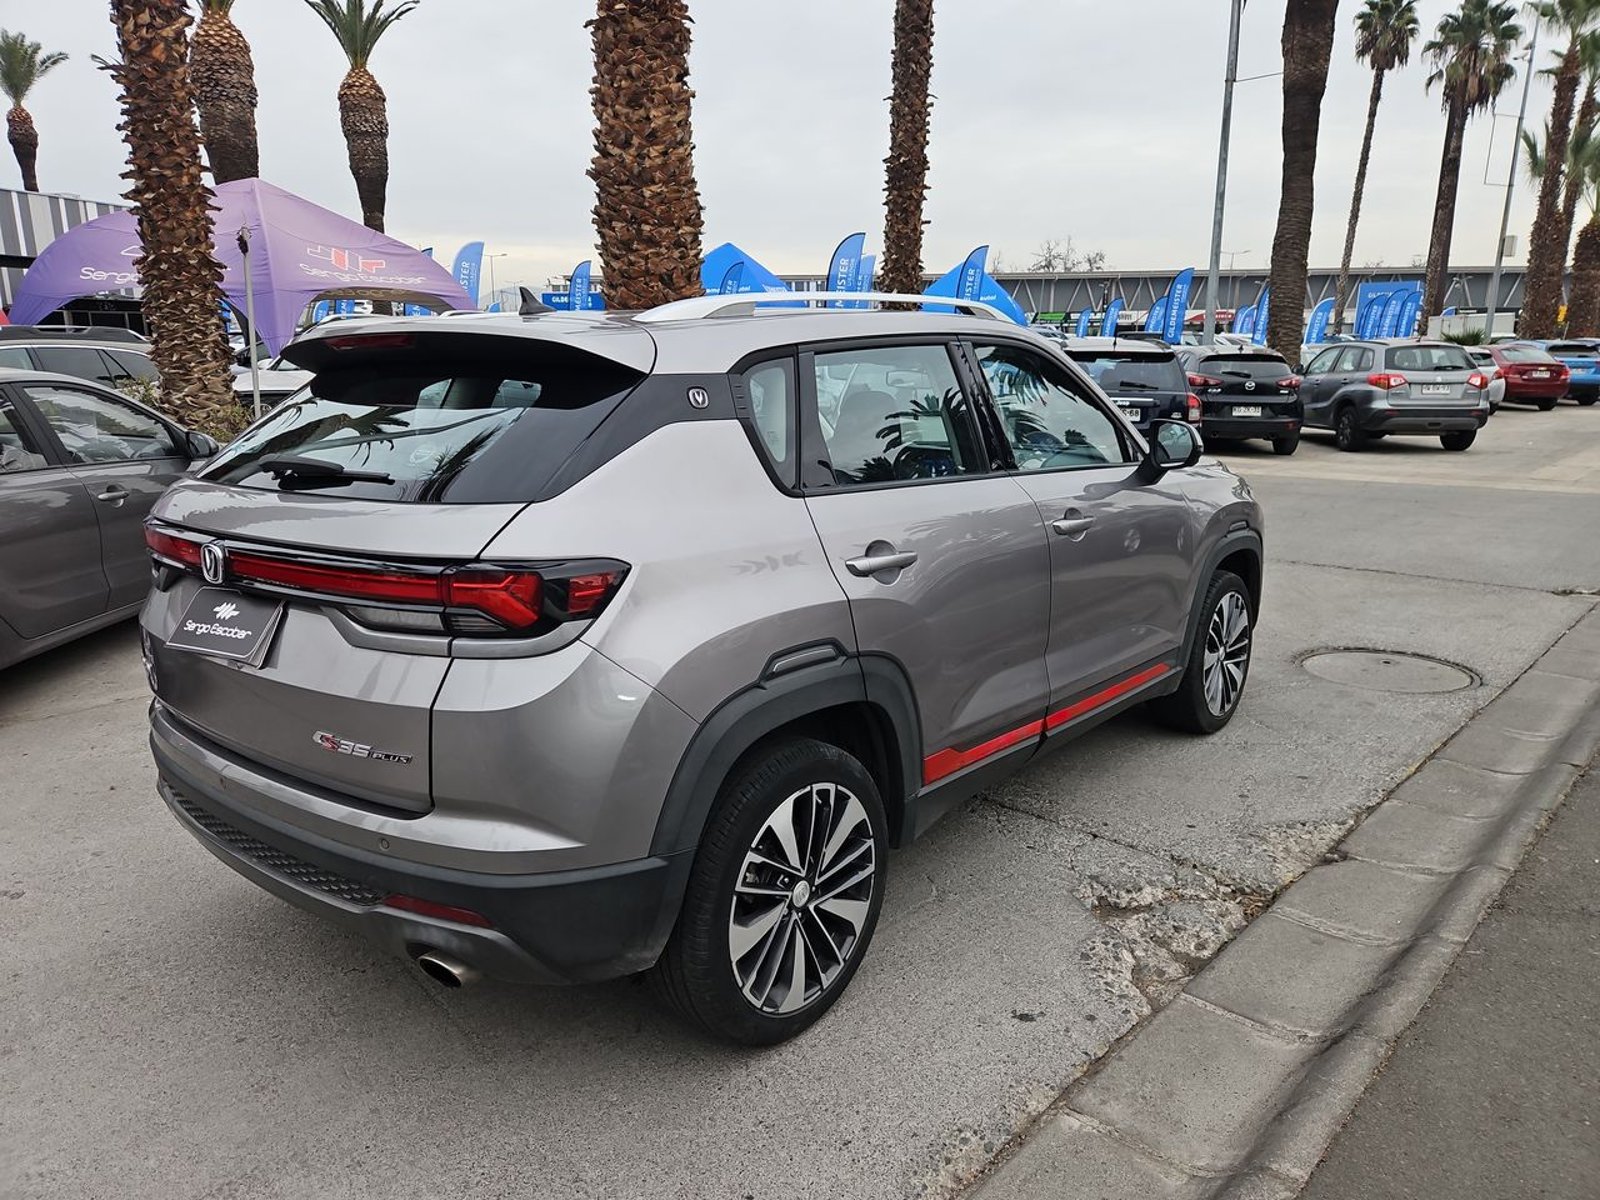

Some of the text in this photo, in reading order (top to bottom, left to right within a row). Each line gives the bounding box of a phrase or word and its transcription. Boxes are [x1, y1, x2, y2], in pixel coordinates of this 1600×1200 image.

[1167, 283, 1184, 339] GILDEMEISTER
[183, 619, 252, 639] Sergo Escobar
